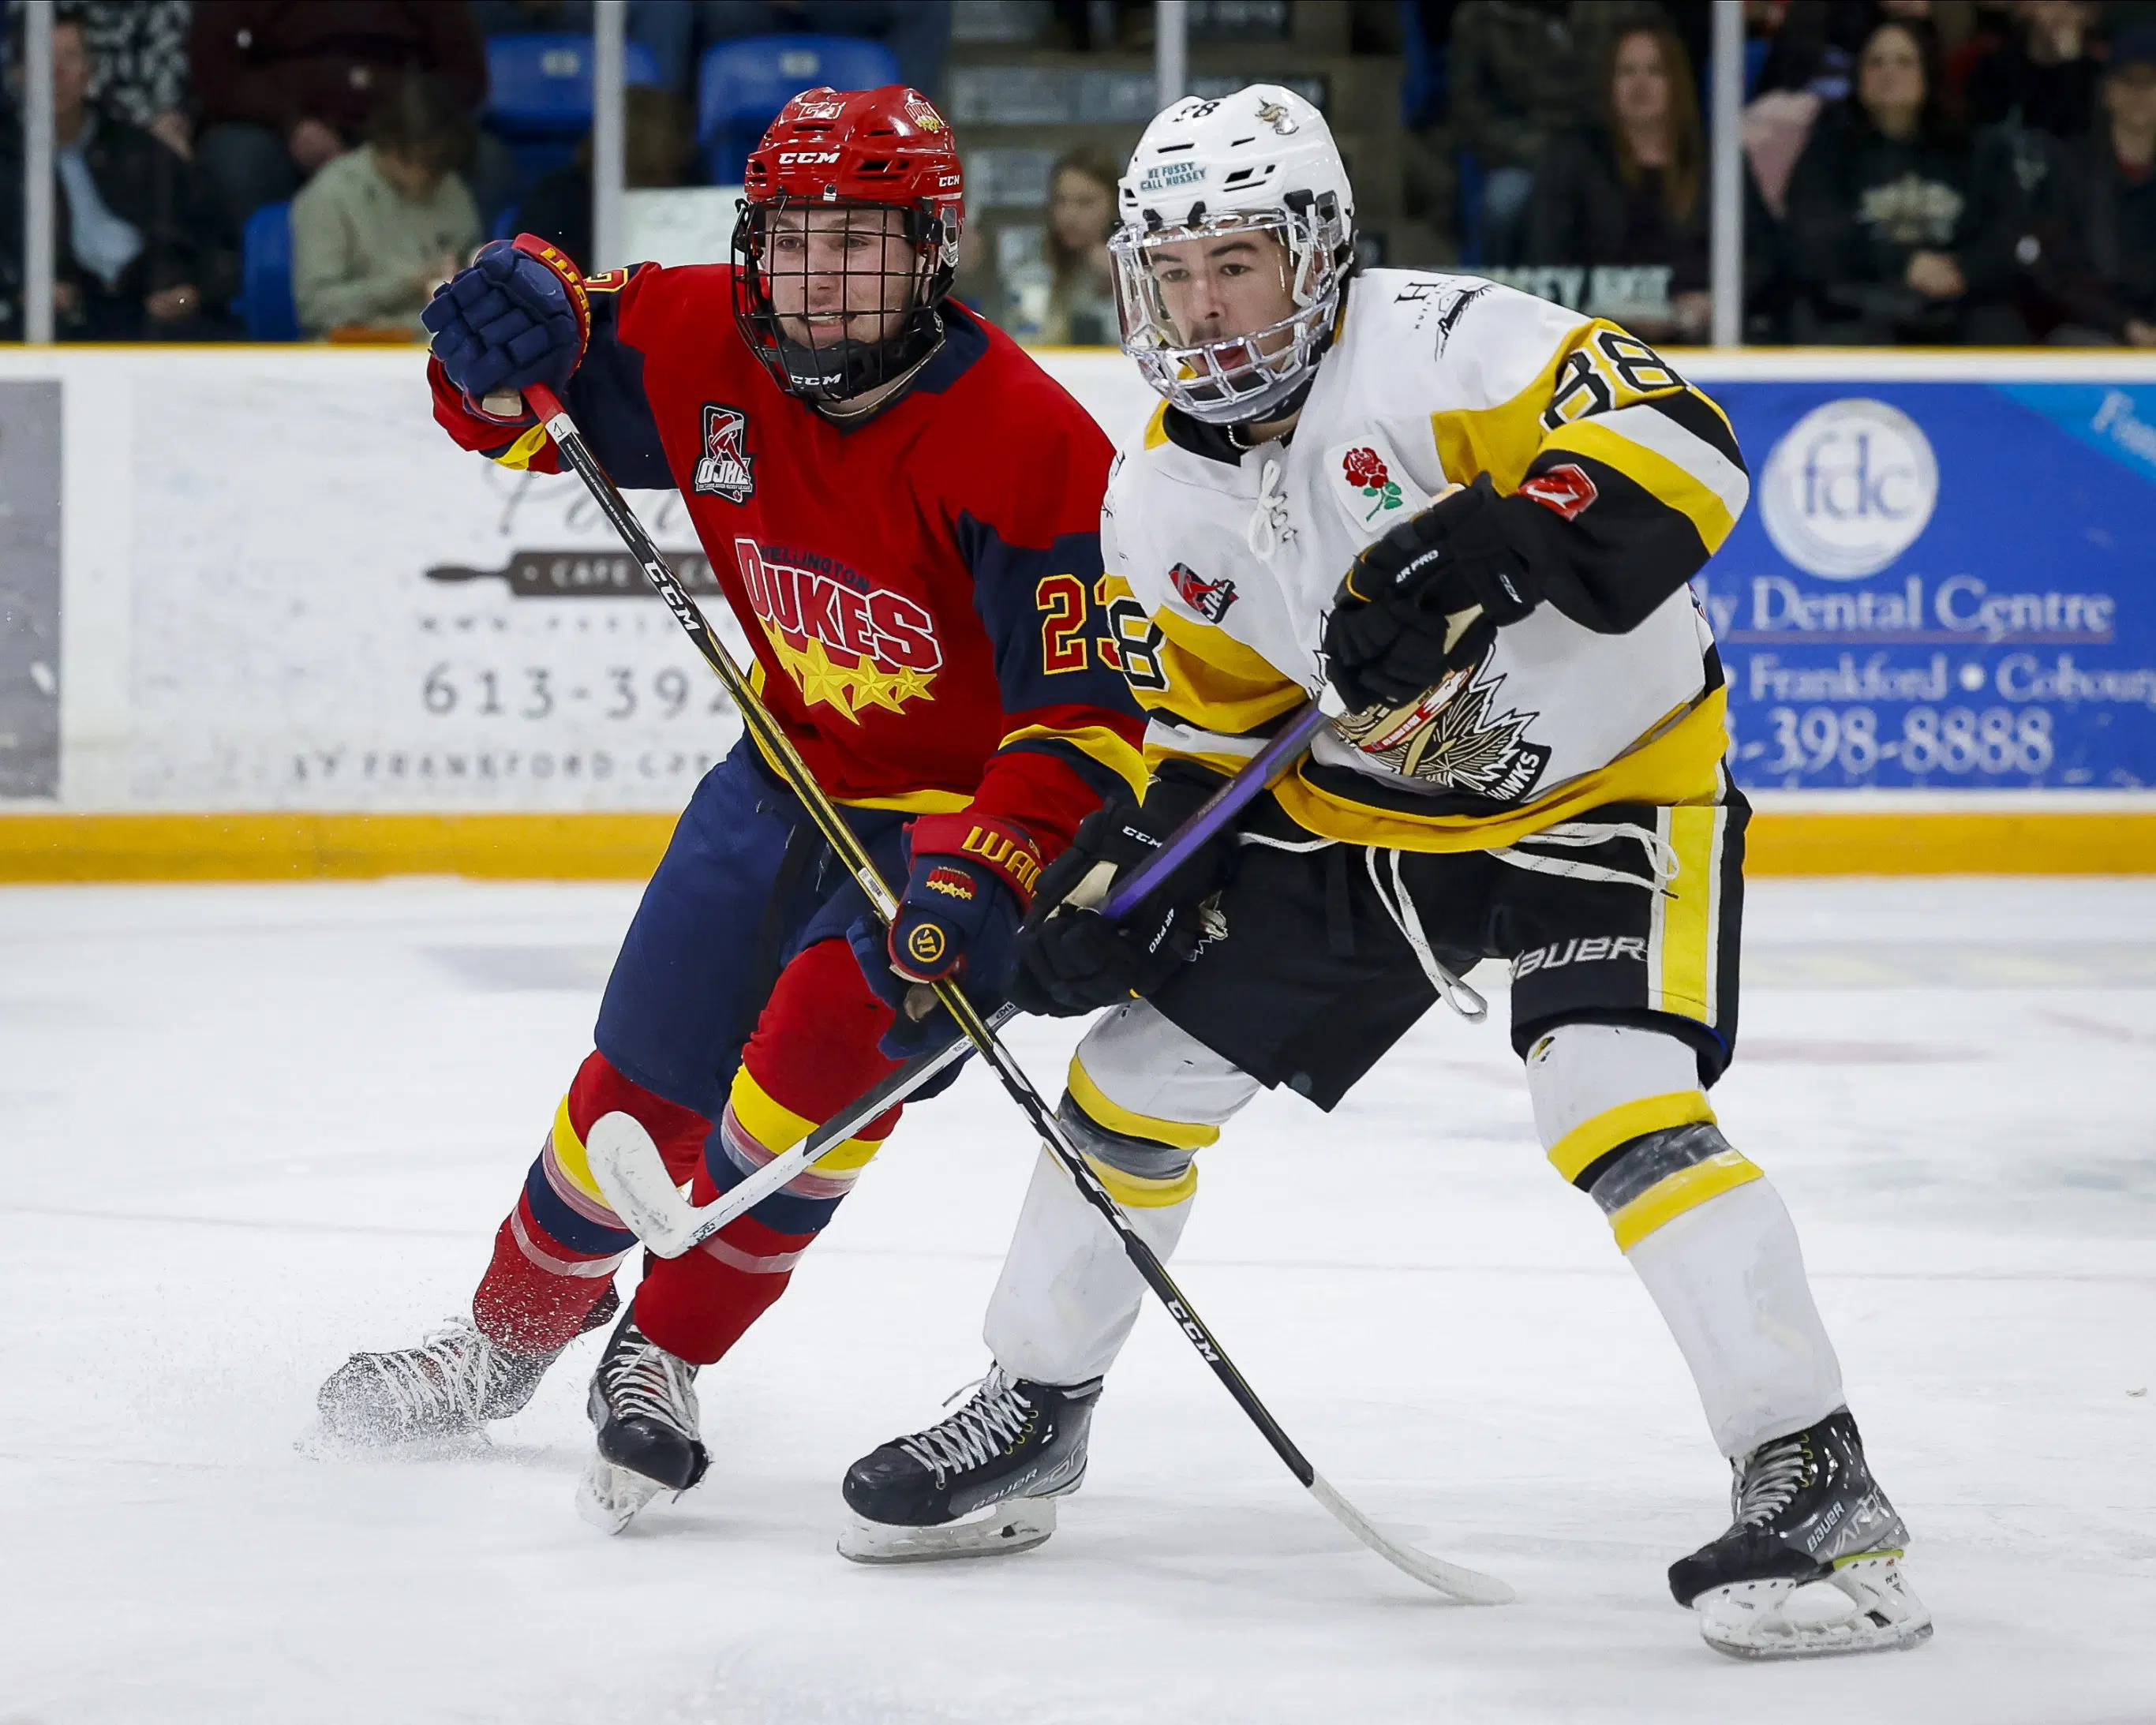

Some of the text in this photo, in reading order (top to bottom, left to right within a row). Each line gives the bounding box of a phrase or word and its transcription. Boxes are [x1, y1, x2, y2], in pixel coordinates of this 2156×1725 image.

[778, 152, 841, 164] CCM
[938, 174, 960, 187] CCM
[1140, 167, 1207, 191] CALL HUSSEY
[1162, 161, 1195, 177] FUSSY
[790, 373, 842, 385] CCM
[695, 458, 750, 485] OJHL
[1802, 431, 1914, 519] fdc
[759, 544, 871, 592] WELLINGTON
[644, 559, 701, 631] CCM
[735, 537, 943, 672] DUKES
[1751, 574, 1922, 631] Dental
[1934, 574, 2115, 634] Centre
[1749, 652, 1947, 701] Frankford
[1486, 751, 1540, 800] HAWKS
[1122, 825, 1163, 848] CCM
[1167, 1299, 1219, 1362] CCM
[1806, 1500, 1846, 1553] BAUER
